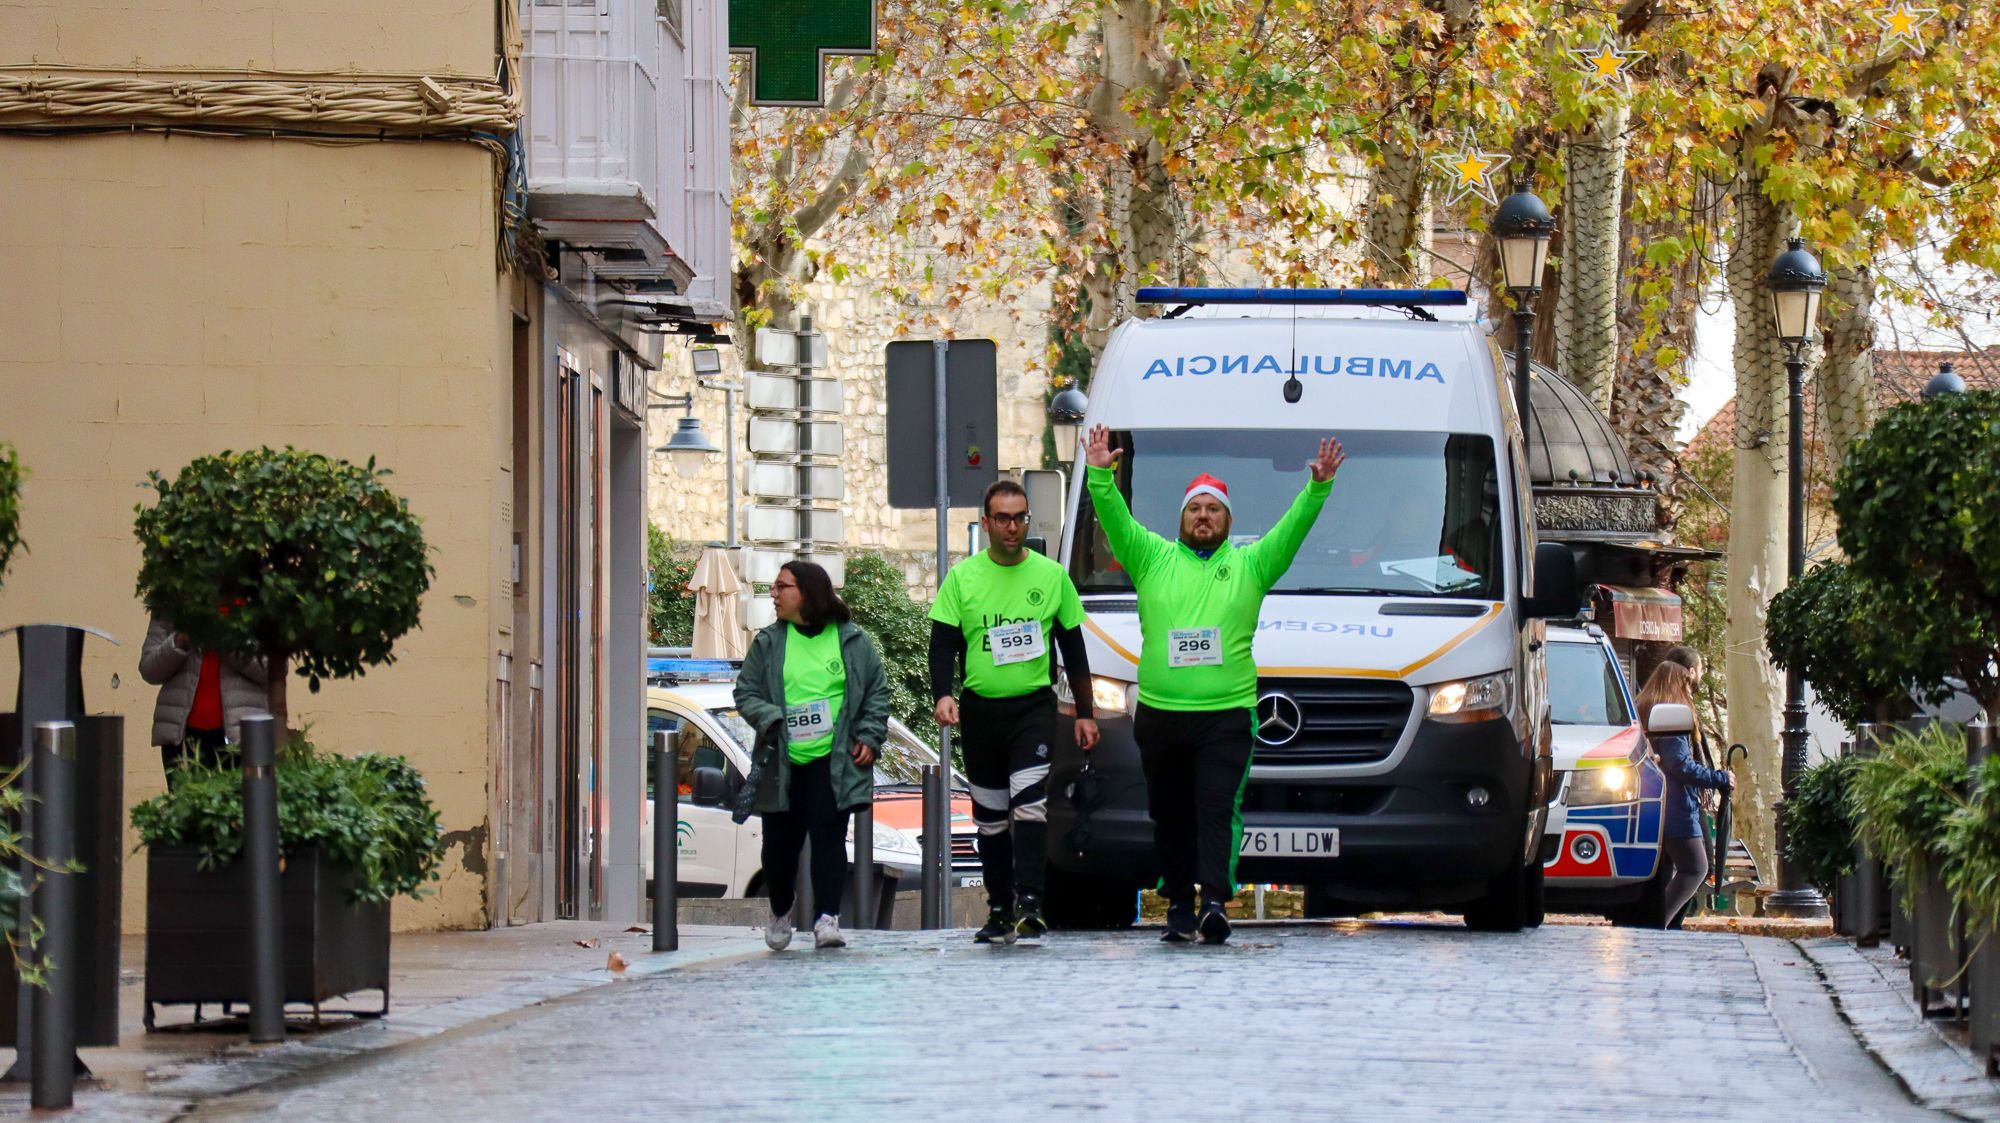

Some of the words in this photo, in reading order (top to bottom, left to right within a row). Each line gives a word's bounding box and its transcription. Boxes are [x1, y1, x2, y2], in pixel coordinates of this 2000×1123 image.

[1001, 634, 1033, 648] 593
[1178, 639, 1210, 652] 296
[788, 714, 822, 728] 588
[1240, 832, 1279, 853] 761
[1291, 832, 1334, 853] LDW
